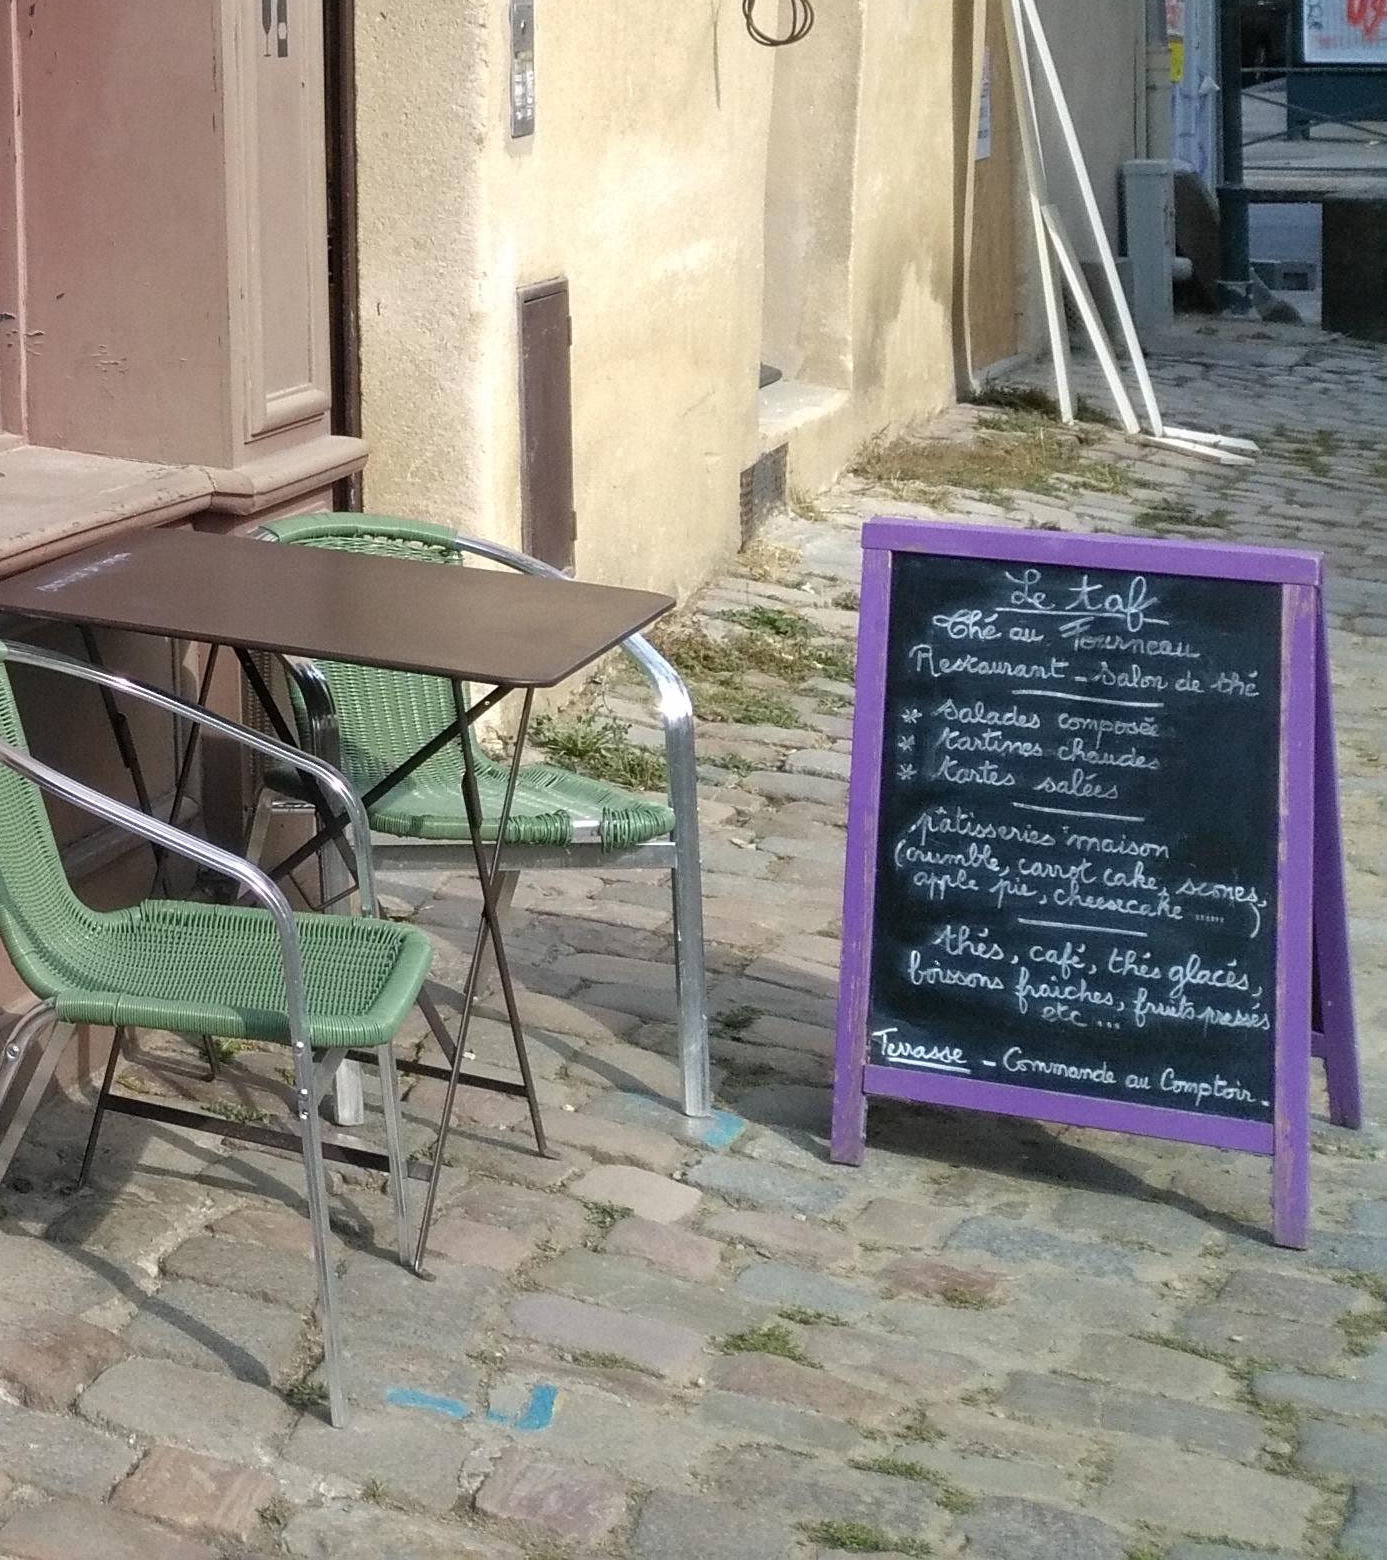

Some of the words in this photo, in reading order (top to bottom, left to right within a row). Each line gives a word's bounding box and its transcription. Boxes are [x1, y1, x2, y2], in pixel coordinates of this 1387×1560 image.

[1005, 568, 1056, 610] Le
[1065, 574, 1159, 632] taf
[932, 608, 1002, 641] Thé
[1009, 624, 1044, 644] au
[1058, 617, 1202, 659] Fourneau
[907, 644, 1069, 678] Restaurant
[1174, 671, 1205, 694] de
[1211, 671, 1260, 698] thé
[1057, 738, 1161, 771] chaudes
[1033, 768, 1120, 801] salées
[1067, 825, 1170, 860] maison
[913, 869, 980, 901] apple
[1018, 856, 1097, 884] carrot
[1108, 947, 1162, 981] thés
[908, 949, 1005, 992] boissons
[1132, 986, 1196, 1028] fruits
[1195, 1003, 1271, 1038] pressés
[871, 1027, 968, 1065] Terrasse
[1002, 1045, 1117, 1086] Commande
[1126, 1070, 1152, 1091] au
